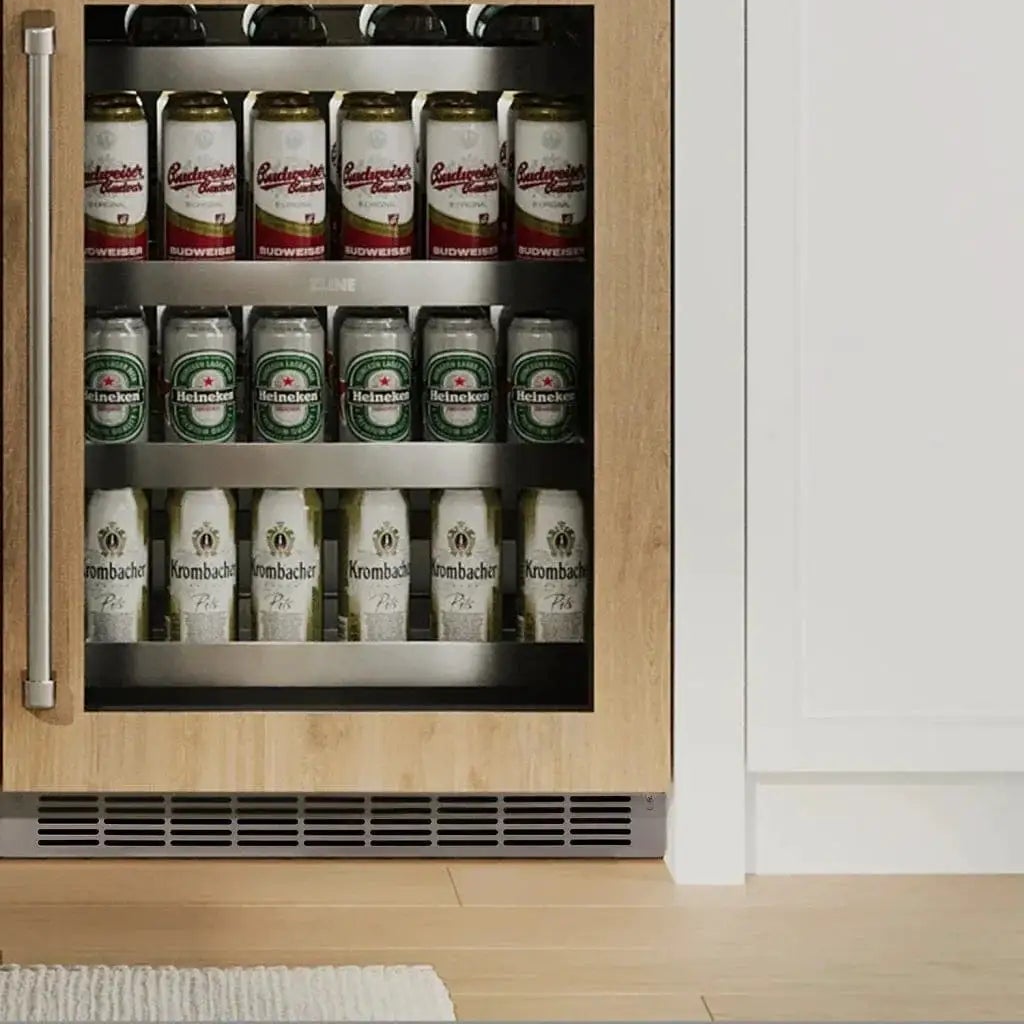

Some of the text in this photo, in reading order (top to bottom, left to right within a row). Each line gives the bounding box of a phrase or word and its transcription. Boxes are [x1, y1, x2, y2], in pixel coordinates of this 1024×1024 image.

[84, 165, 144, 187] udweiser
[84, 246, 144, 256] DWEISER
[85, 391, 140, 403] eineken
[176, 390, 235, 403] Heineken
[258, 389, 319, 403] Heineken
[352, 389, 411, 403] Heineken
[430, 389, 490, 403] Heineken
[85, 561, 146, 581] rombacher
[525, 560, 586, 581] Krombach
